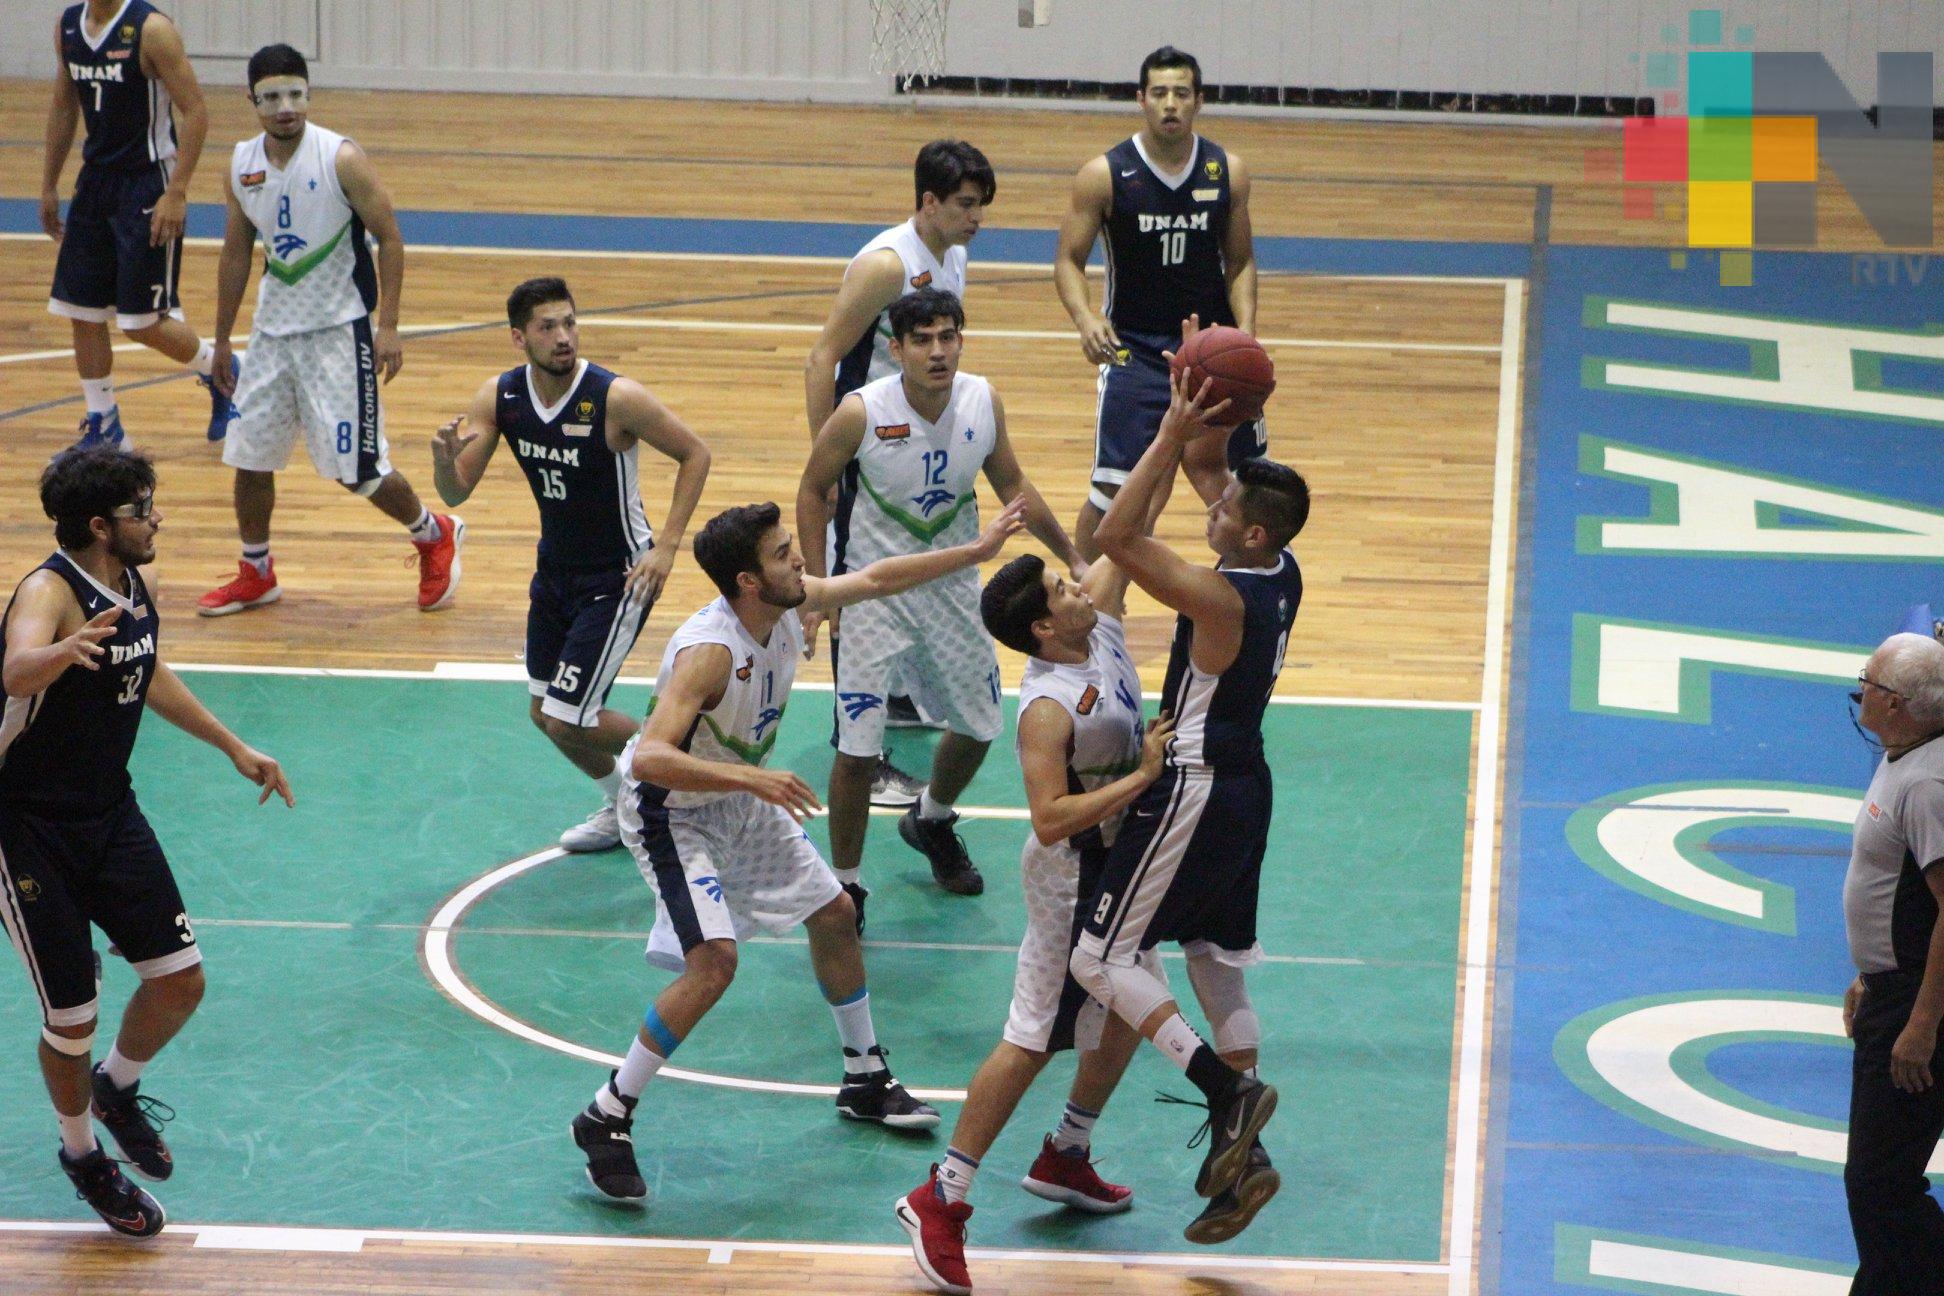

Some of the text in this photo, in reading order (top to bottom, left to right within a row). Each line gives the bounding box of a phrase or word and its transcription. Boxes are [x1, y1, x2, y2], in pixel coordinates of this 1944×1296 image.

[69, 62, 123, 82] UNAM
[90, 81, 102, 112] 7
[278, 195, 291, 229] 8
[1138, 211, 1208, 233] UNAM
[1160, 232, 1186, 266] 10
[150, 284, 164, 309] 7
[360, 342, 376, 454] Halcones UV
[336, 421, 352, 454] 8
[1252, 416, 1267, 448] 10
[518, 438, 580, 467] UNAM
[922, 449, 948, 486] 12
[538, 467, 567, 500] 15
[110, 633, 155, 665] UNAM
[117, 665, 144, 705] 32
[550, 660, 582, 692] 15
[1093, 891, 1113, 924] 9
